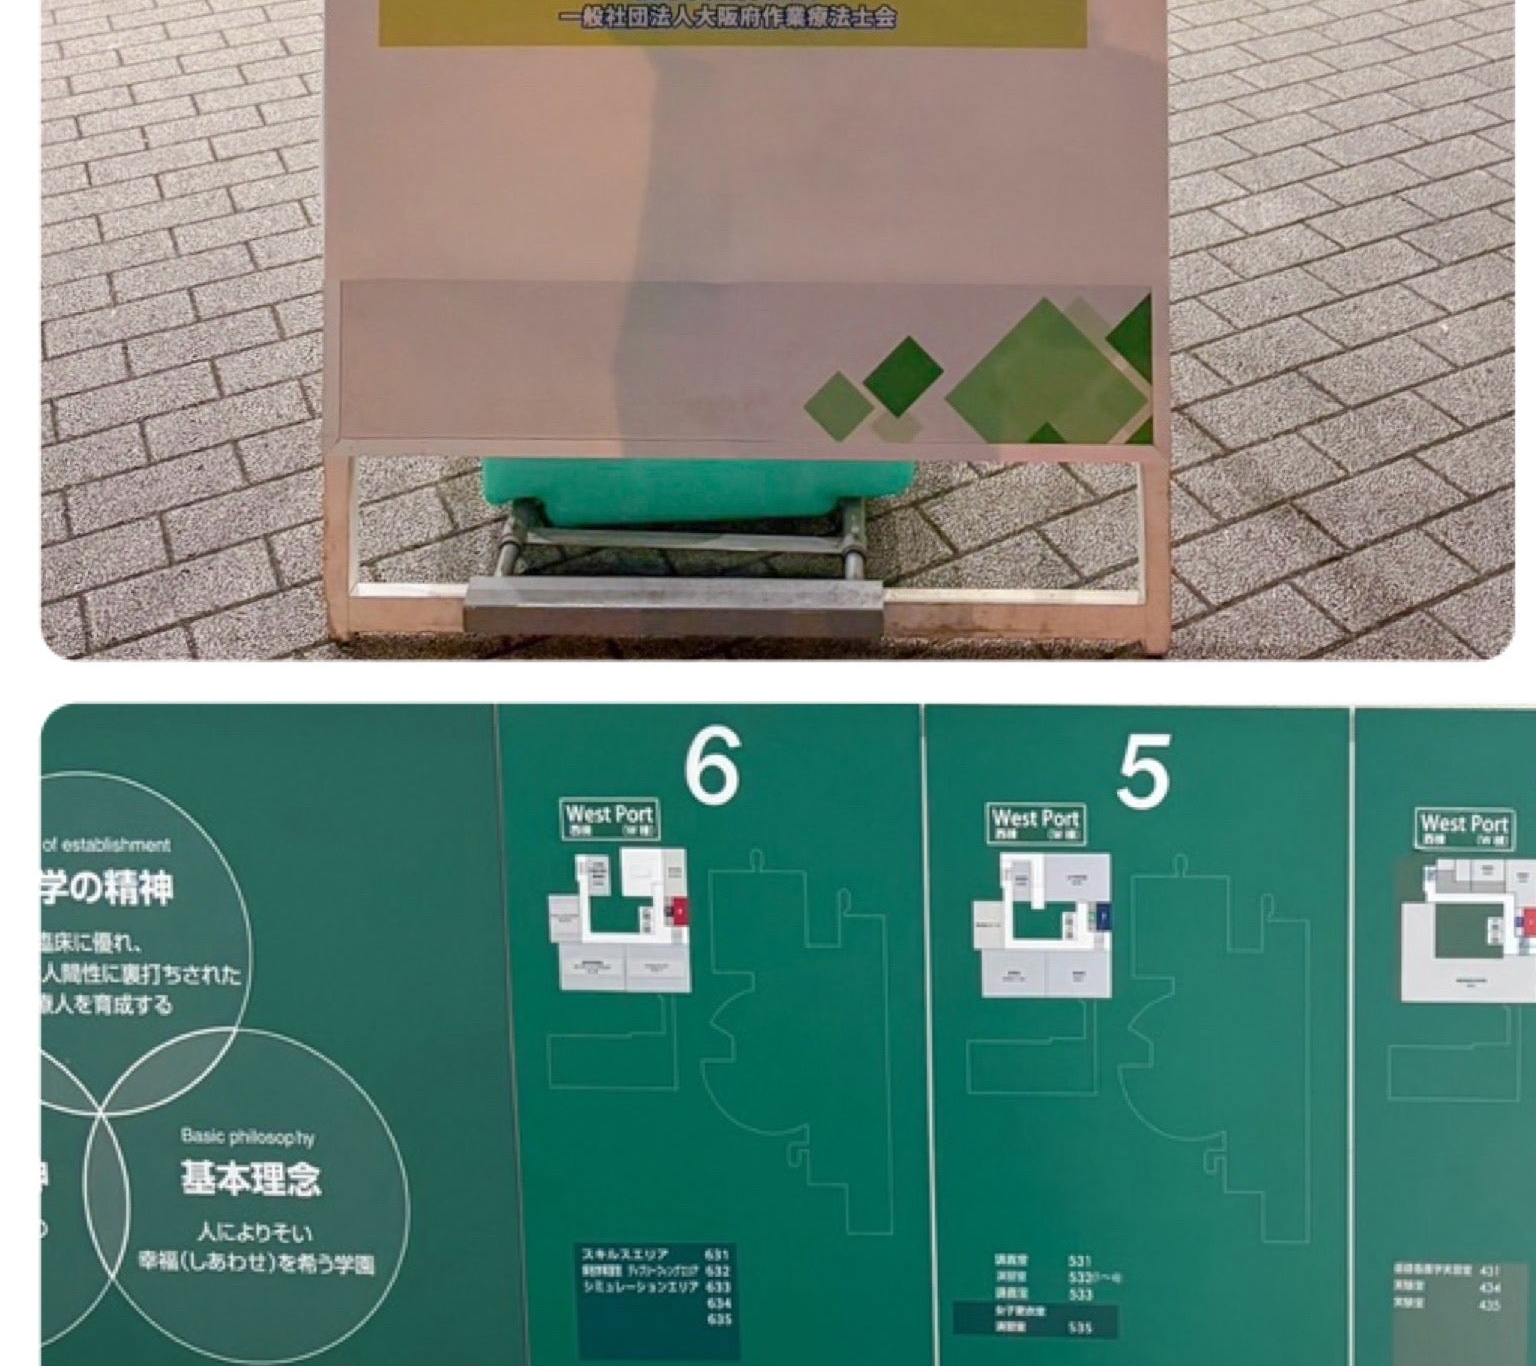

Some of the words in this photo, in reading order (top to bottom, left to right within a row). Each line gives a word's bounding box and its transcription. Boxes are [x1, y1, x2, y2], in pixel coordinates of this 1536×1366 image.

[559, 5, 898, 30] 一般社団法人大阪府作業療法士会
[685, 724, 742, 806] 6
[1116, 733, 1172, 810] 5
[566, 803, 612, 825] West
[616, 803, 655, 825] Port
[991, 808, 1037, 829] West
[1042, 808, 1081, 829] Port
[1421, 814, 1467, 833] West
[1472, 815, 1509, 834] Port
[43, 837, 58, 852] of
[62, 837, 172, 853] establishment
[181, 1127, 226, 1144] Basic
[229, 1128, 316, 1148] philosophy
[181, 1160, 323, 1197] 基本理念
[197, 1222, 313, 1244] 人によりそい
